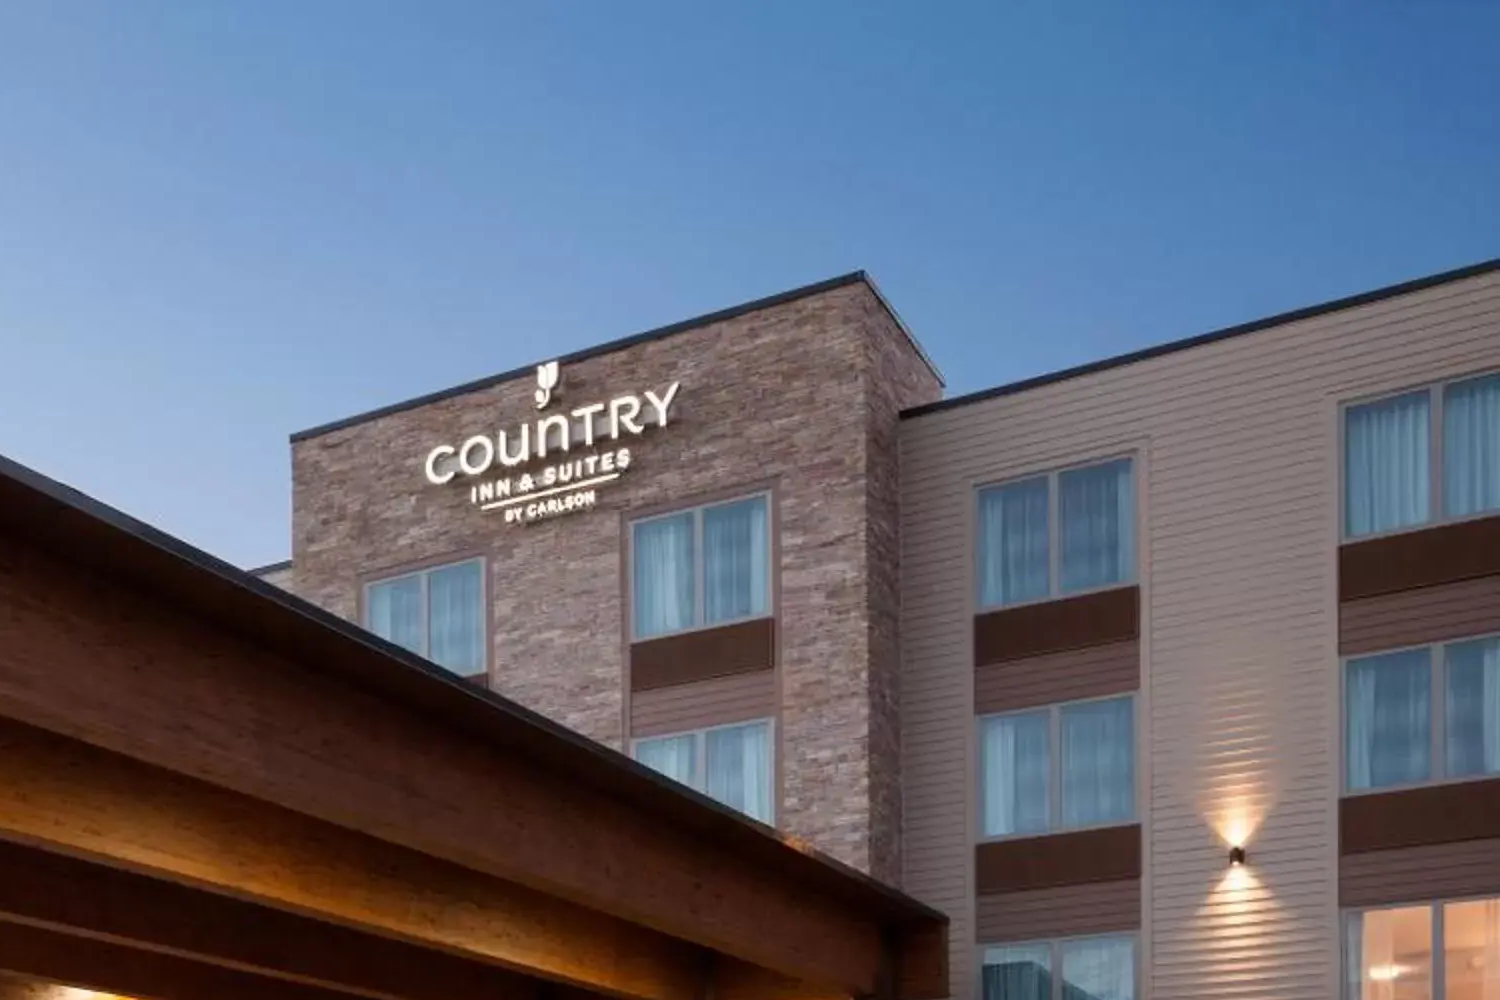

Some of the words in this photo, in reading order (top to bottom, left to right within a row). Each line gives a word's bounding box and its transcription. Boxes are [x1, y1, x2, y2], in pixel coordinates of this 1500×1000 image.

[471, 479, 510, 503] INN
[518, 473, 535, 491] &
[543, 448, 631, 487] SUITES
[505, 506, 522, 523] BY
[526, 490, 596, 518] CARLSON
